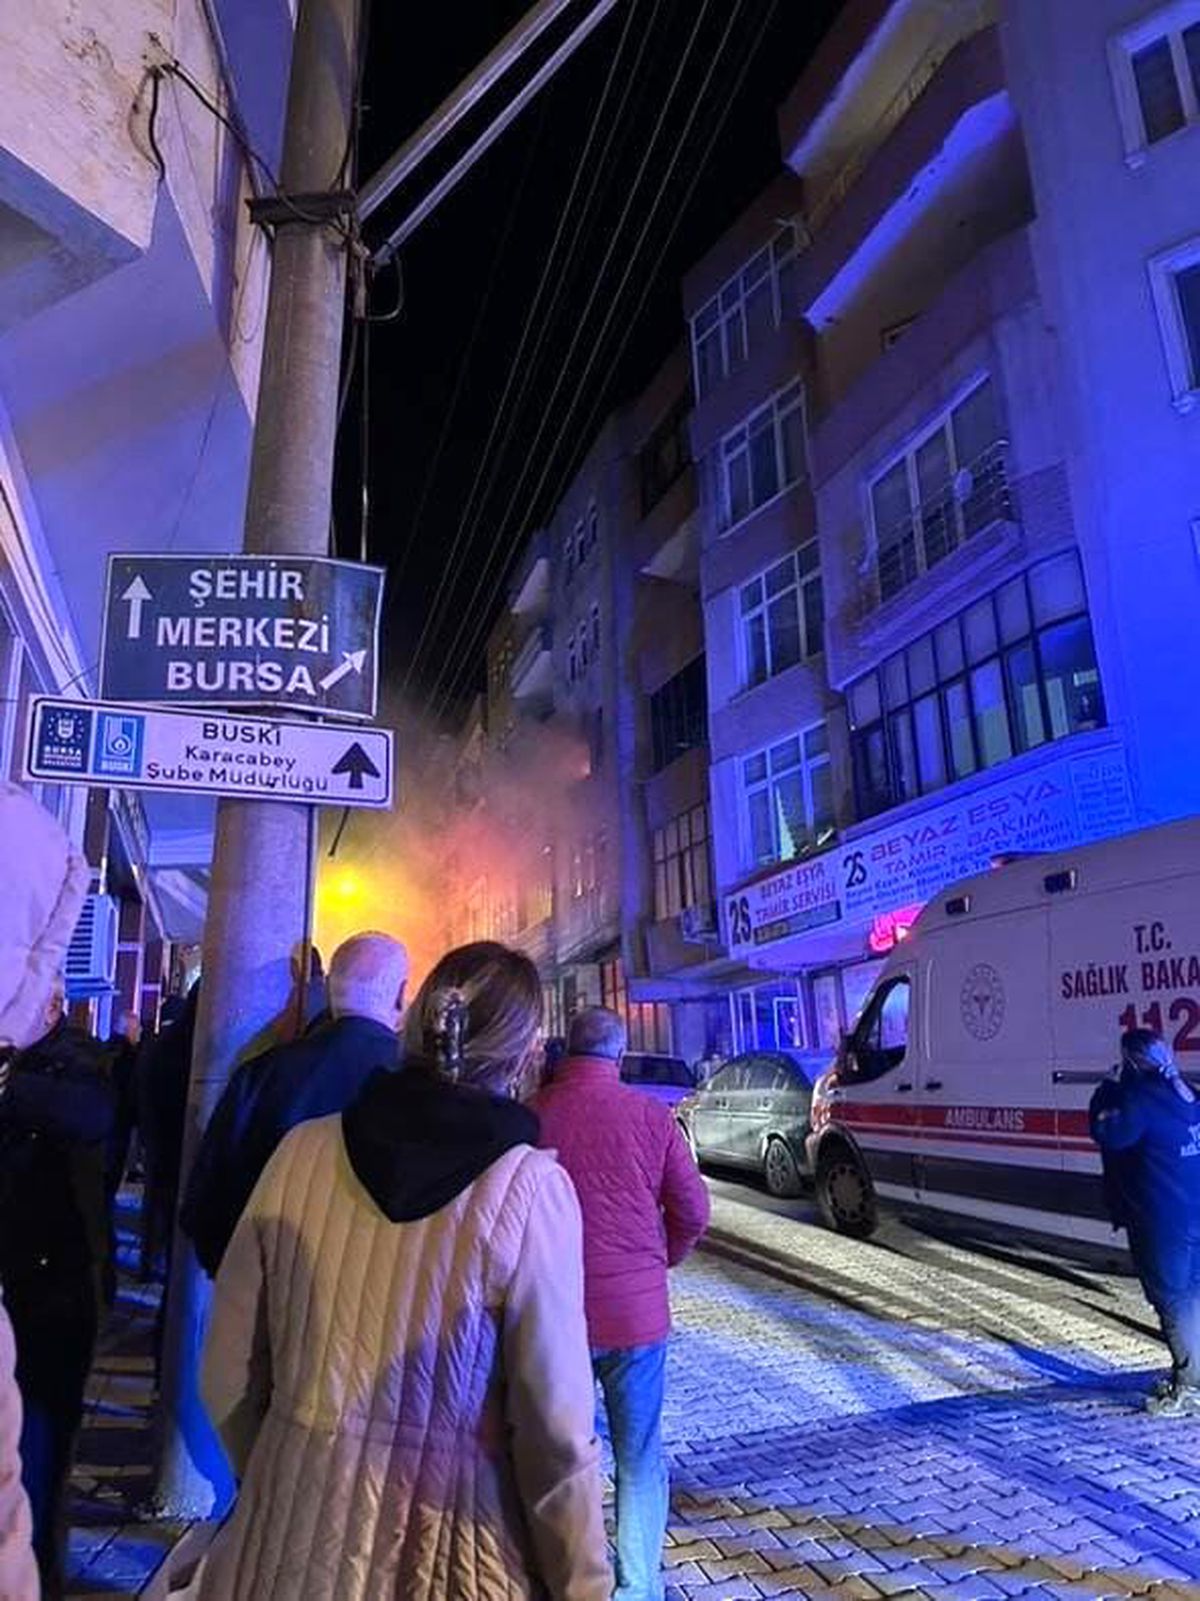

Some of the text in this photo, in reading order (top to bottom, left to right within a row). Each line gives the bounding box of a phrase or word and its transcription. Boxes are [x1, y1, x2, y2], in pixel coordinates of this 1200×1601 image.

[189, 562, 304, 607] ŞEHİR
[156, 615, 329, 653] MERKEZİ
[166, 660, 317, 696] BURSA
[185, 745, 297, 772] Karacabey
[870, 813, 959, 862] BEYAZ
[729, 896, 751, 945] 2S
[1133, 921, 1172, 953] T.C.
[1061, 956, 1200, 999] SAĞLIK BAKA
[943, 1108, 1025, 1132] AMBULANS
